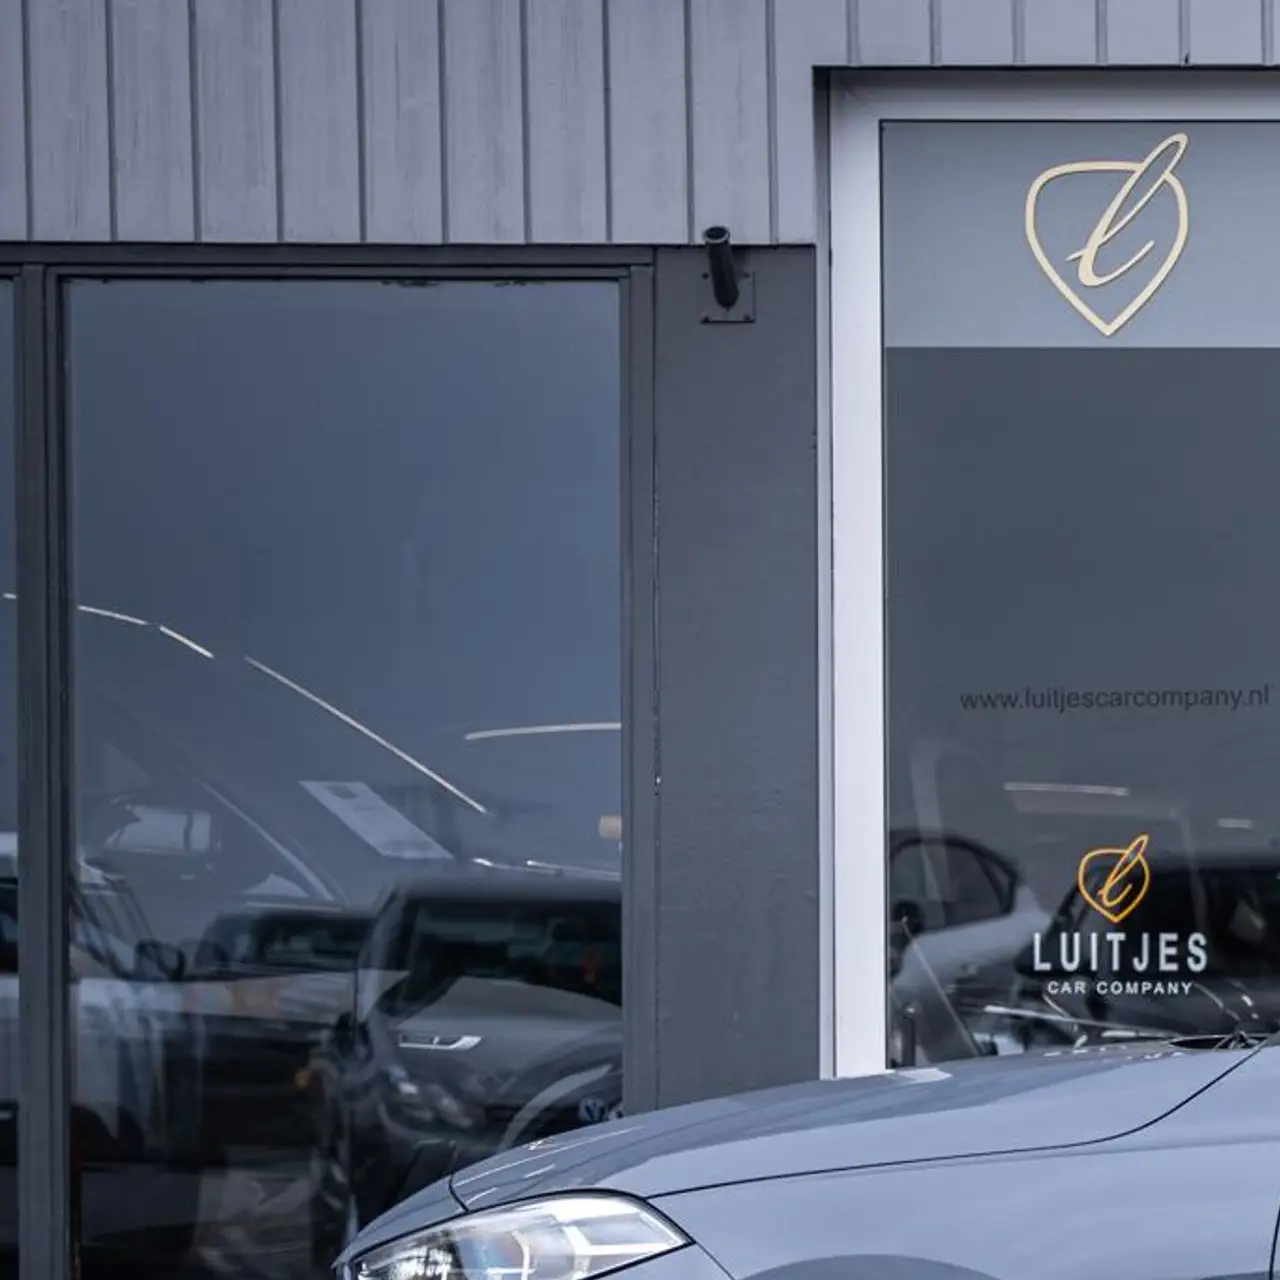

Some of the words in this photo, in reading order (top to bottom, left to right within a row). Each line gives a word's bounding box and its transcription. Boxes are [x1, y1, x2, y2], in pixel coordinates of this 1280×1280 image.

[959, 684, 1271, 714] www.luitjescarcompany.nl
[1033, 932, 1208, 972] LUITJES
[1047, 981, 1086, 995] CAR
[1096, 981, 1193, 995] COMPANY
